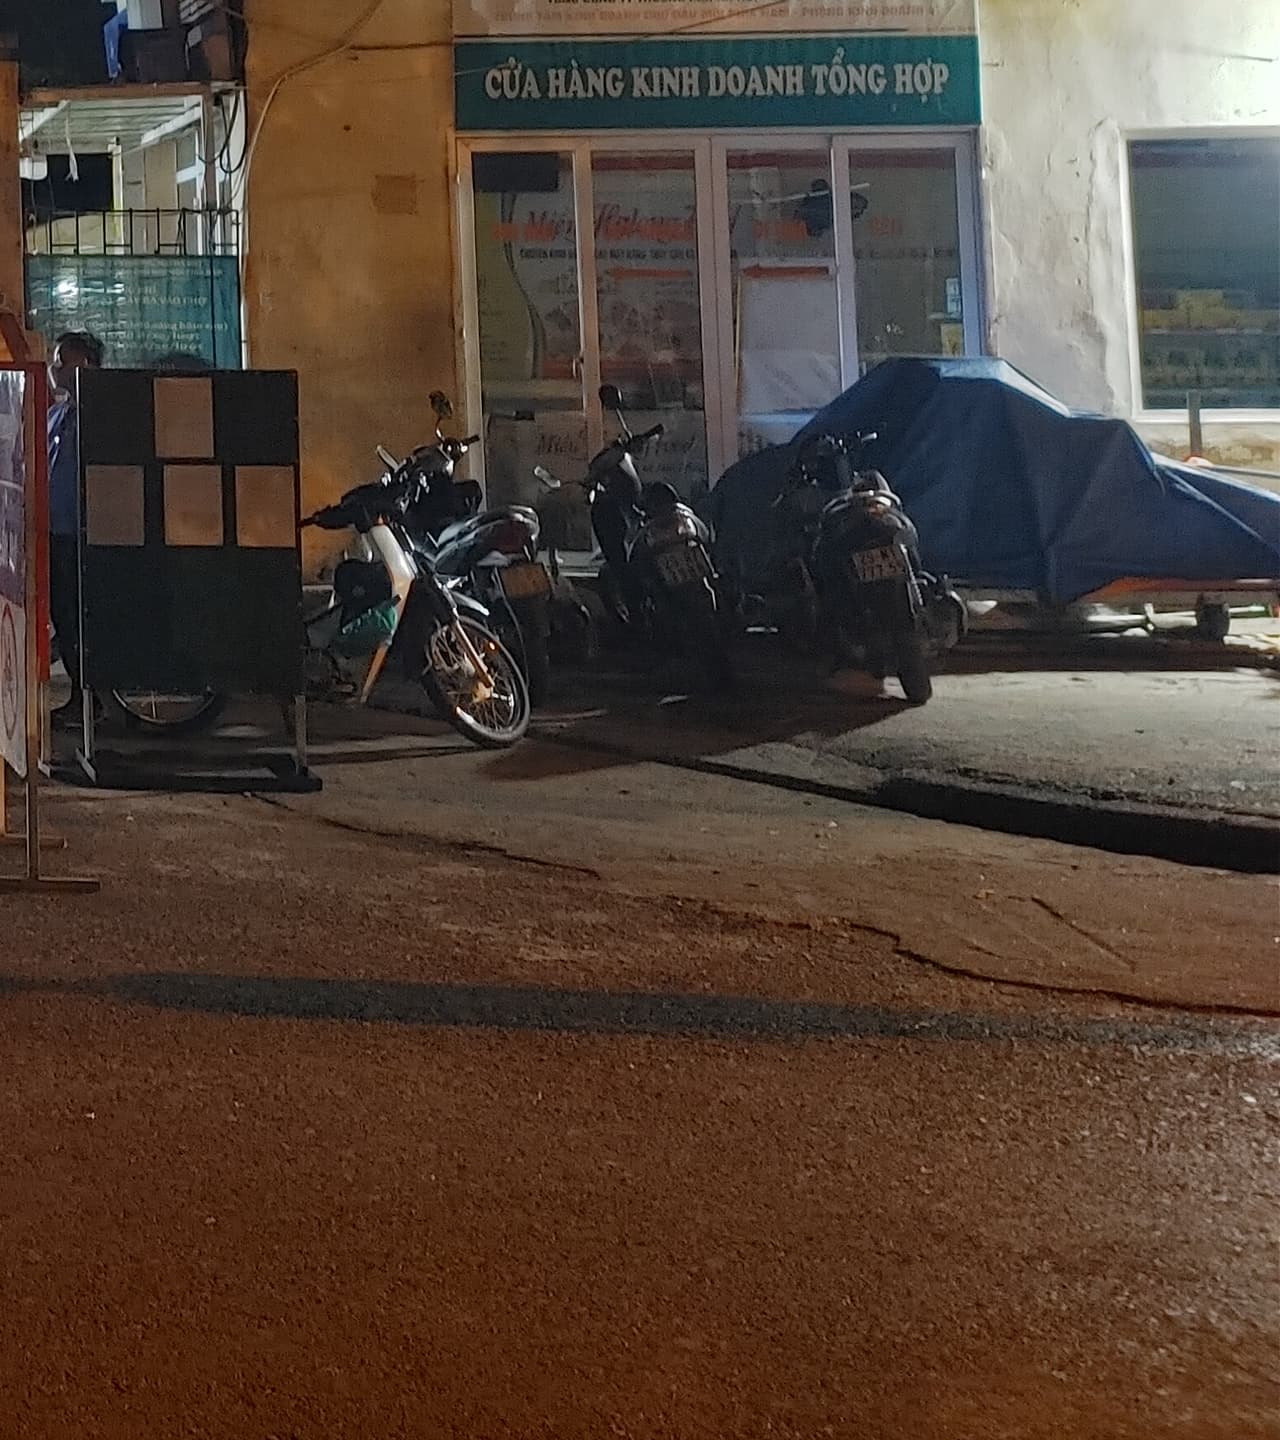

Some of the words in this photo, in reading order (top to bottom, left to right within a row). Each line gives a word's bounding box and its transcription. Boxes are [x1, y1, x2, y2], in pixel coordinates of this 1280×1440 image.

[485, 56, 541, 99] CỬA
[547, 58, 625, 99] HÀNG
[632, 66, 700, 98] KINH
[708, 64, 805, 97] DOANH
[811, 45, 888, 96] TỔNG
[894, 57, 950, 103] HỢP
